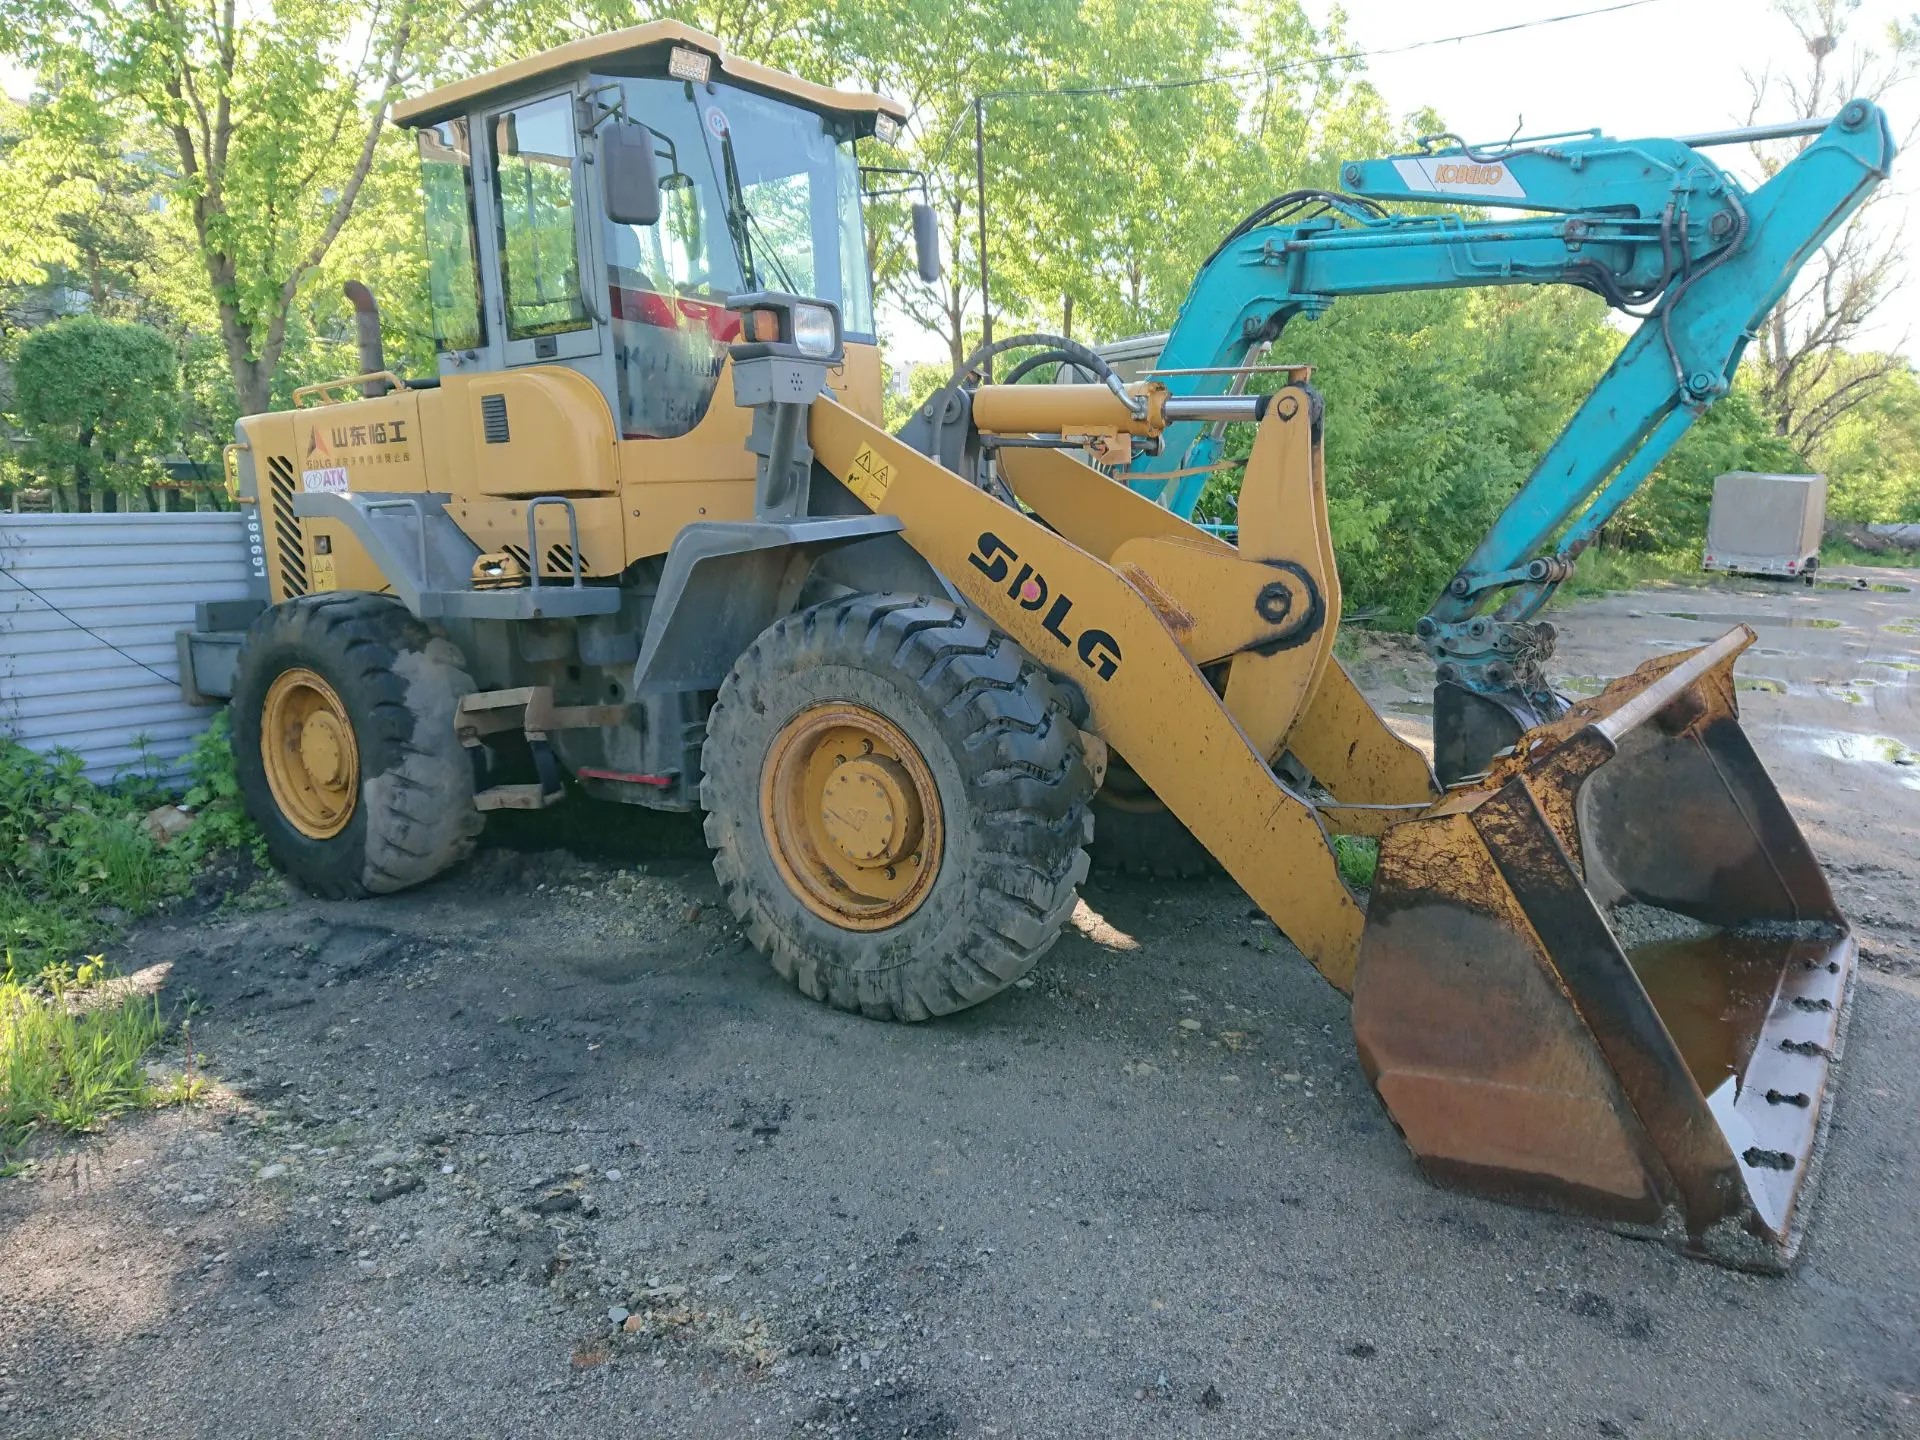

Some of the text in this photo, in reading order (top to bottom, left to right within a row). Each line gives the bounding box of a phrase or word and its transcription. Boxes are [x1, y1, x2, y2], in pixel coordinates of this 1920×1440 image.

[1435, 164, 1503, 186] KOBELCO
[331, 420, 407, 448] 山东临工
[247, 508, 265, 577] LG936L
[967, 531, 1122, 682] SDLG
